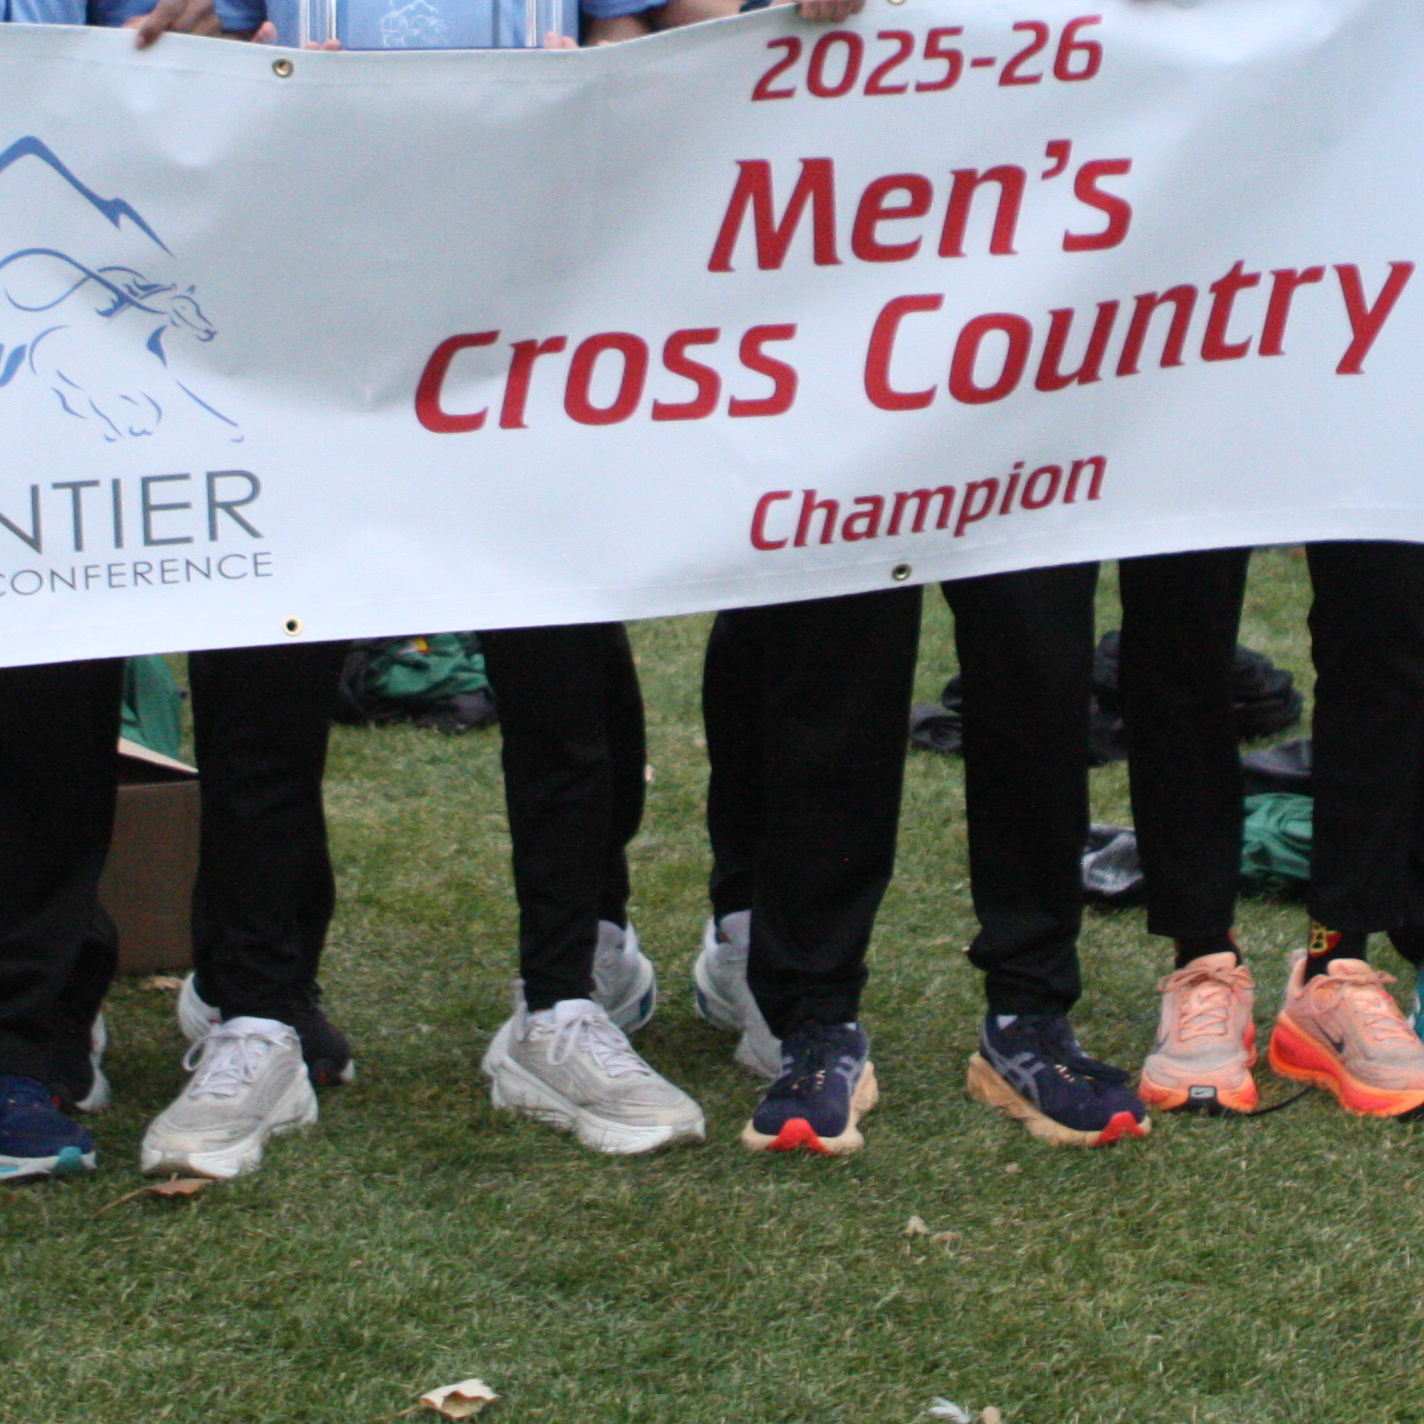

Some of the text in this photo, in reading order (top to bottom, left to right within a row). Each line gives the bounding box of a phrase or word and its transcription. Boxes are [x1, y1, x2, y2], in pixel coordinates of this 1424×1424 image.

[750, 14, 1104, 103] 2025-26
[707, 139, 1133, 274] Men's
[413, 259, 1416, 435] Cross Country
[750, 454, 1109, 552] Champion
